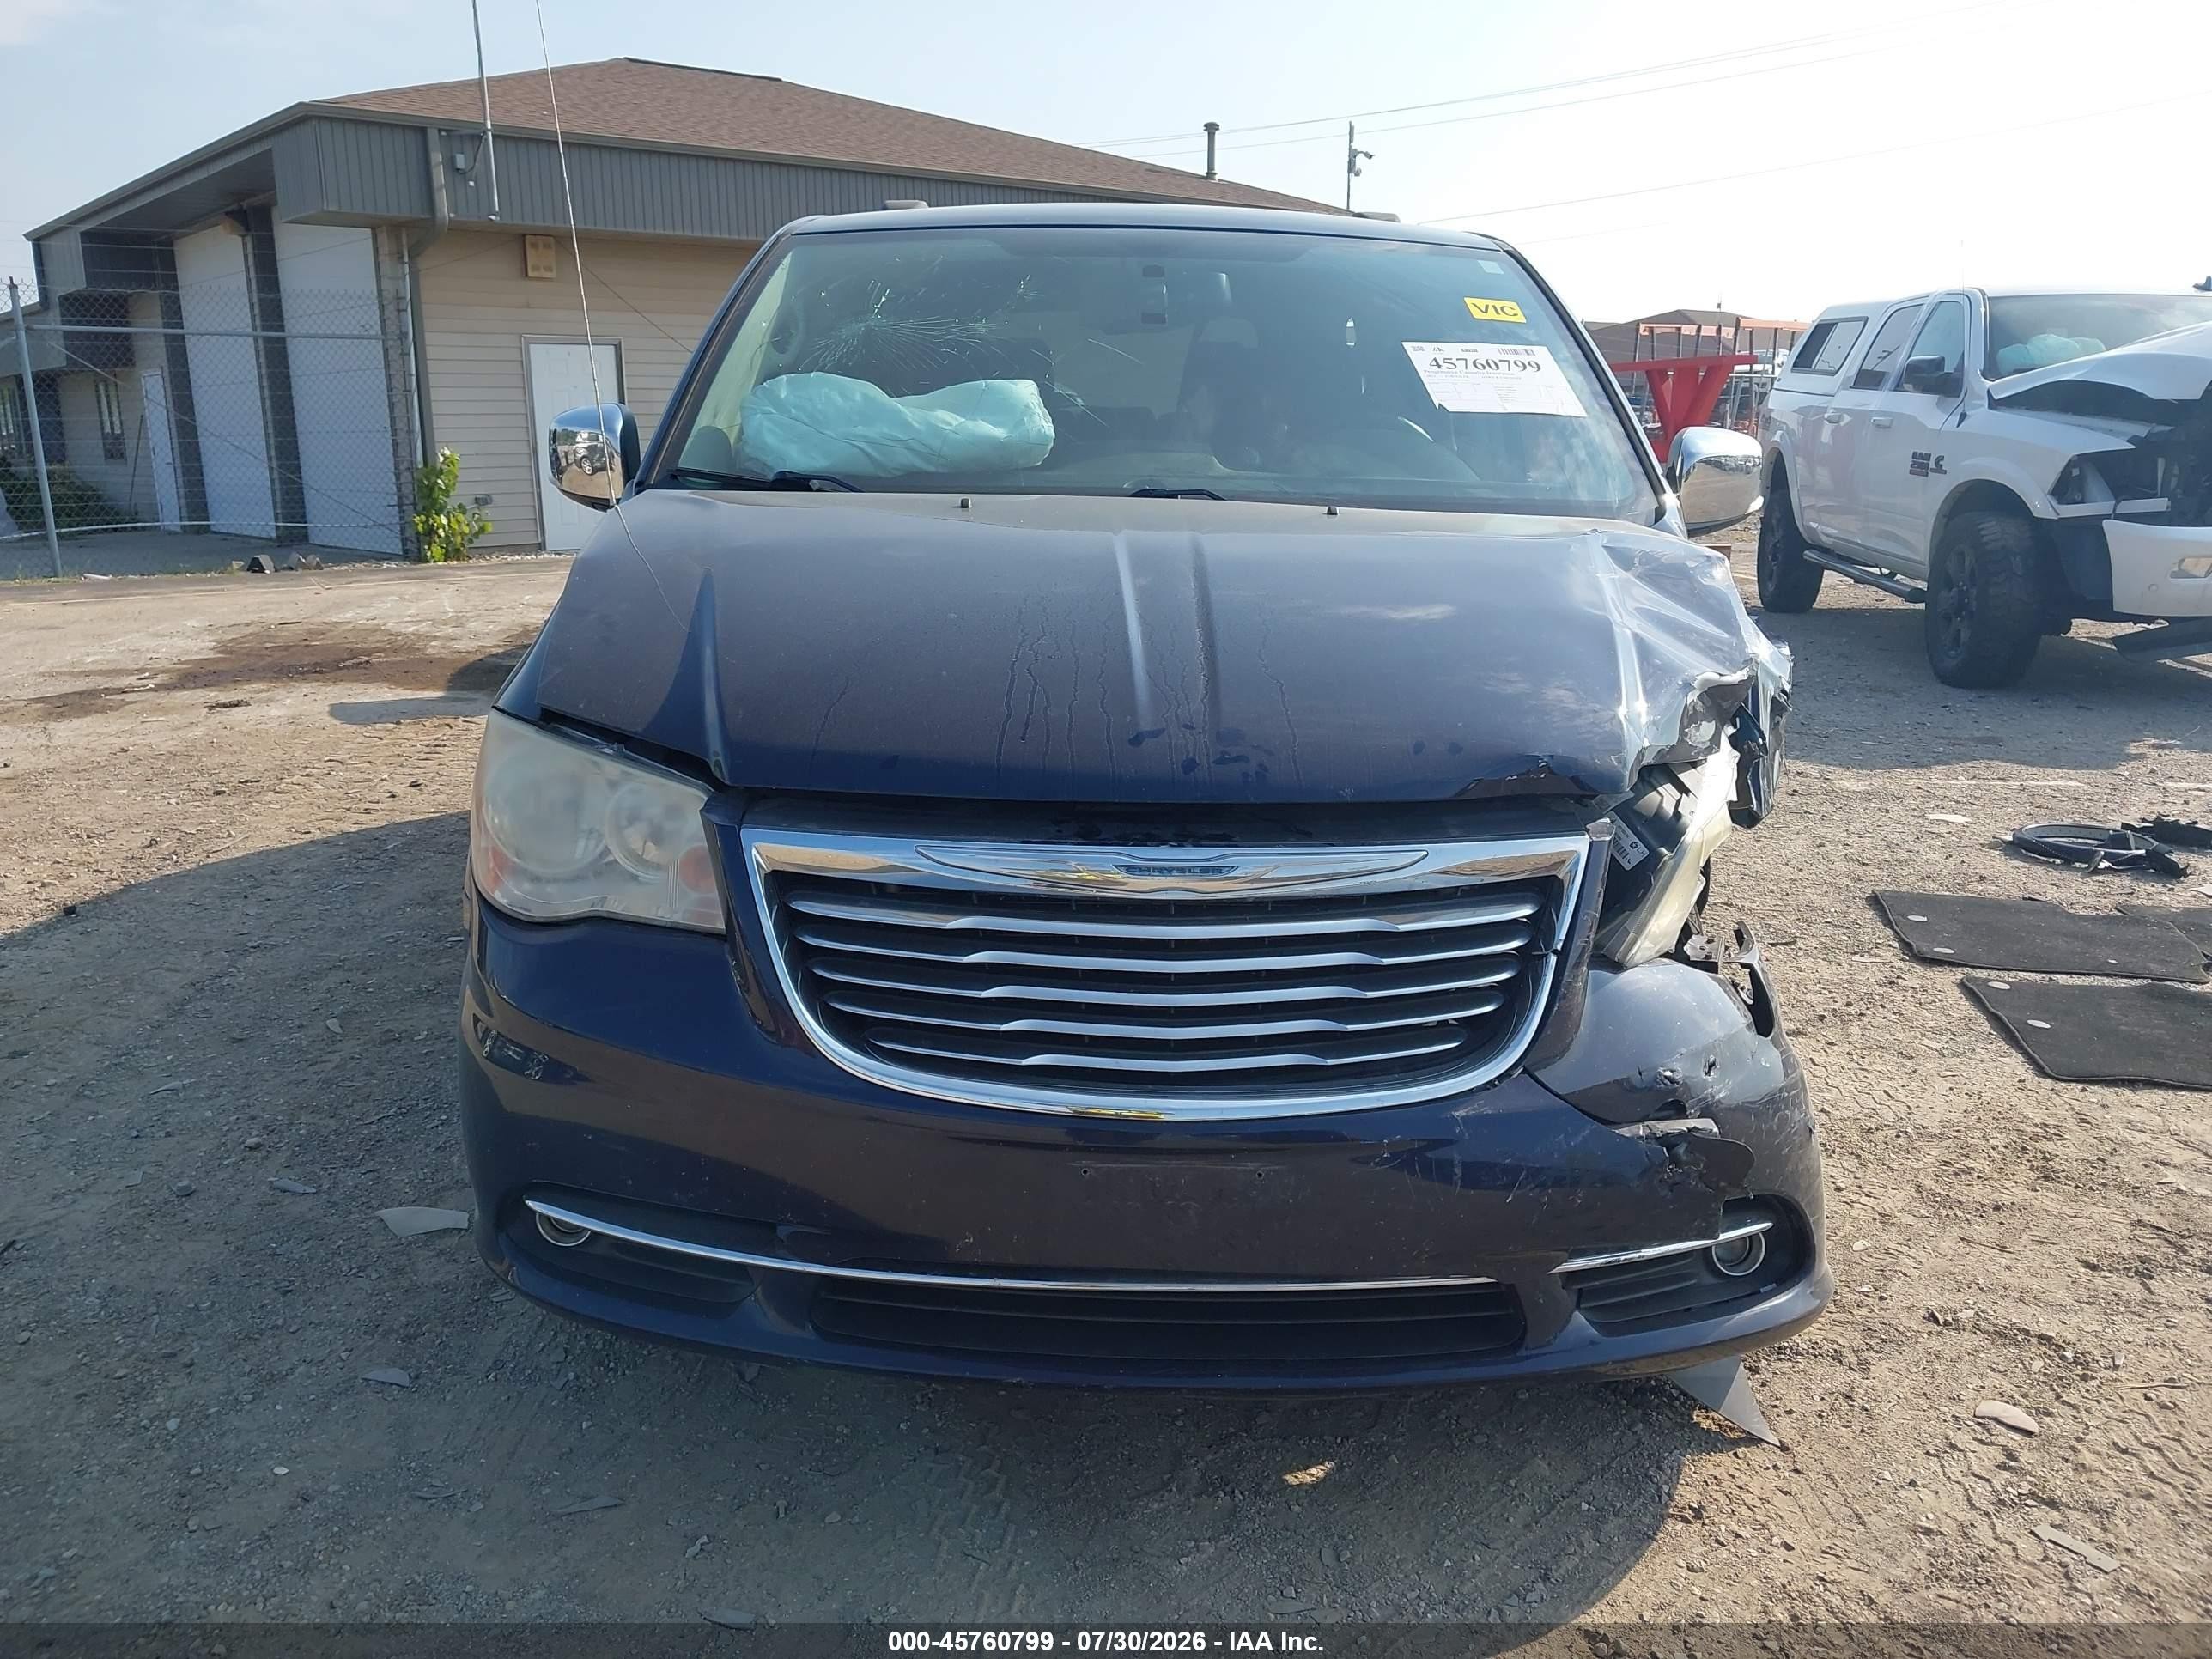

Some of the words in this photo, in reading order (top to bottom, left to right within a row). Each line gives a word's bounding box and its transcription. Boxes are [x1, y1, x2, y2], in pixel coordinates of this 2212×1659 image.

[1470, 302, 1519, 317] VIC
[1429, 356, 1541, 373] 45760799
[1125, 866, 1224, 875] CHRYSLER
